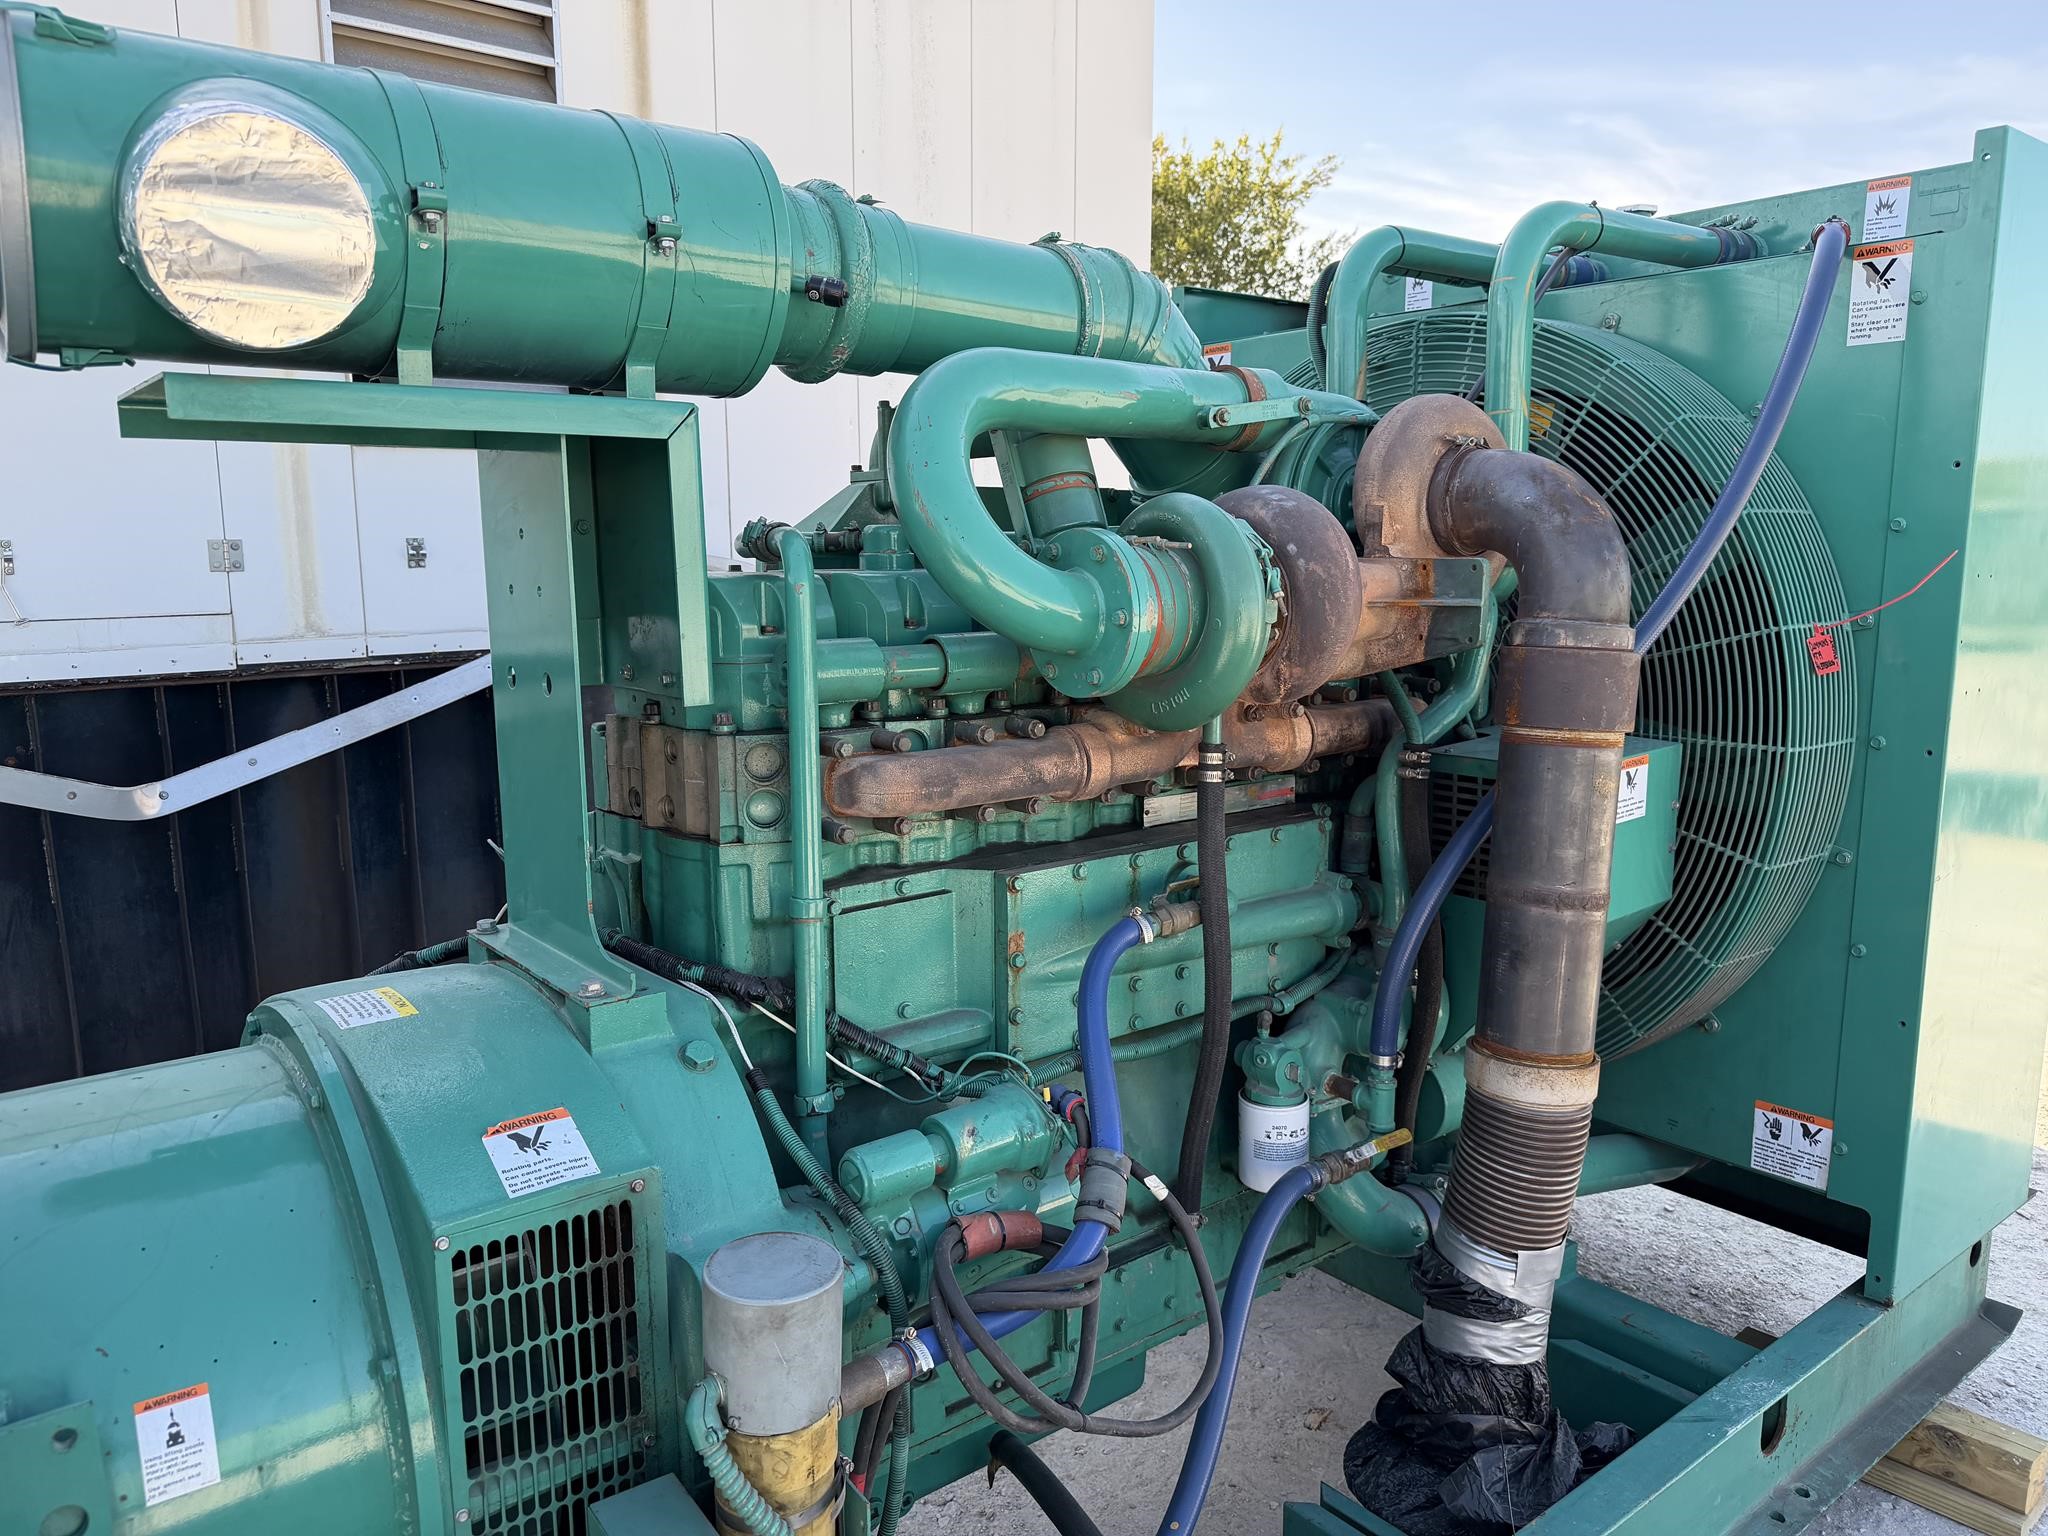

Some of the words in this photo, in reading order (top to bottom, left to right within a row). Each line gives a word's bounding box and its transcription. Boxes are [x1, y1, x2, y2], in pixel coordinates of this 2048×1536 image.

[1875, 179, 1909, 188] WARNING
[1865, 243, 1908, 256] WARNING
[1852, 299, 1877, 307] Rotating
[500, 1112, 557, 1132] WARNING
[1777, 1107, 1815, 1123] WARNING
[501, 1163, 532, 1175] Rotating
[533, 1157, 554, 1166] parts.
[521, 1168, 542, 1177] cause
[544, 1161, 567, 1171] severe
[568, 1155, 590, 1165] injury.
[534, 1170, 561, 1182] operate
[563, 1163, 589, 1172] without
[511, 1183, 535, 1194] guards
[545, 1174, 567, 1184] place.
[152, 1387, 198, 1407] WARNING
